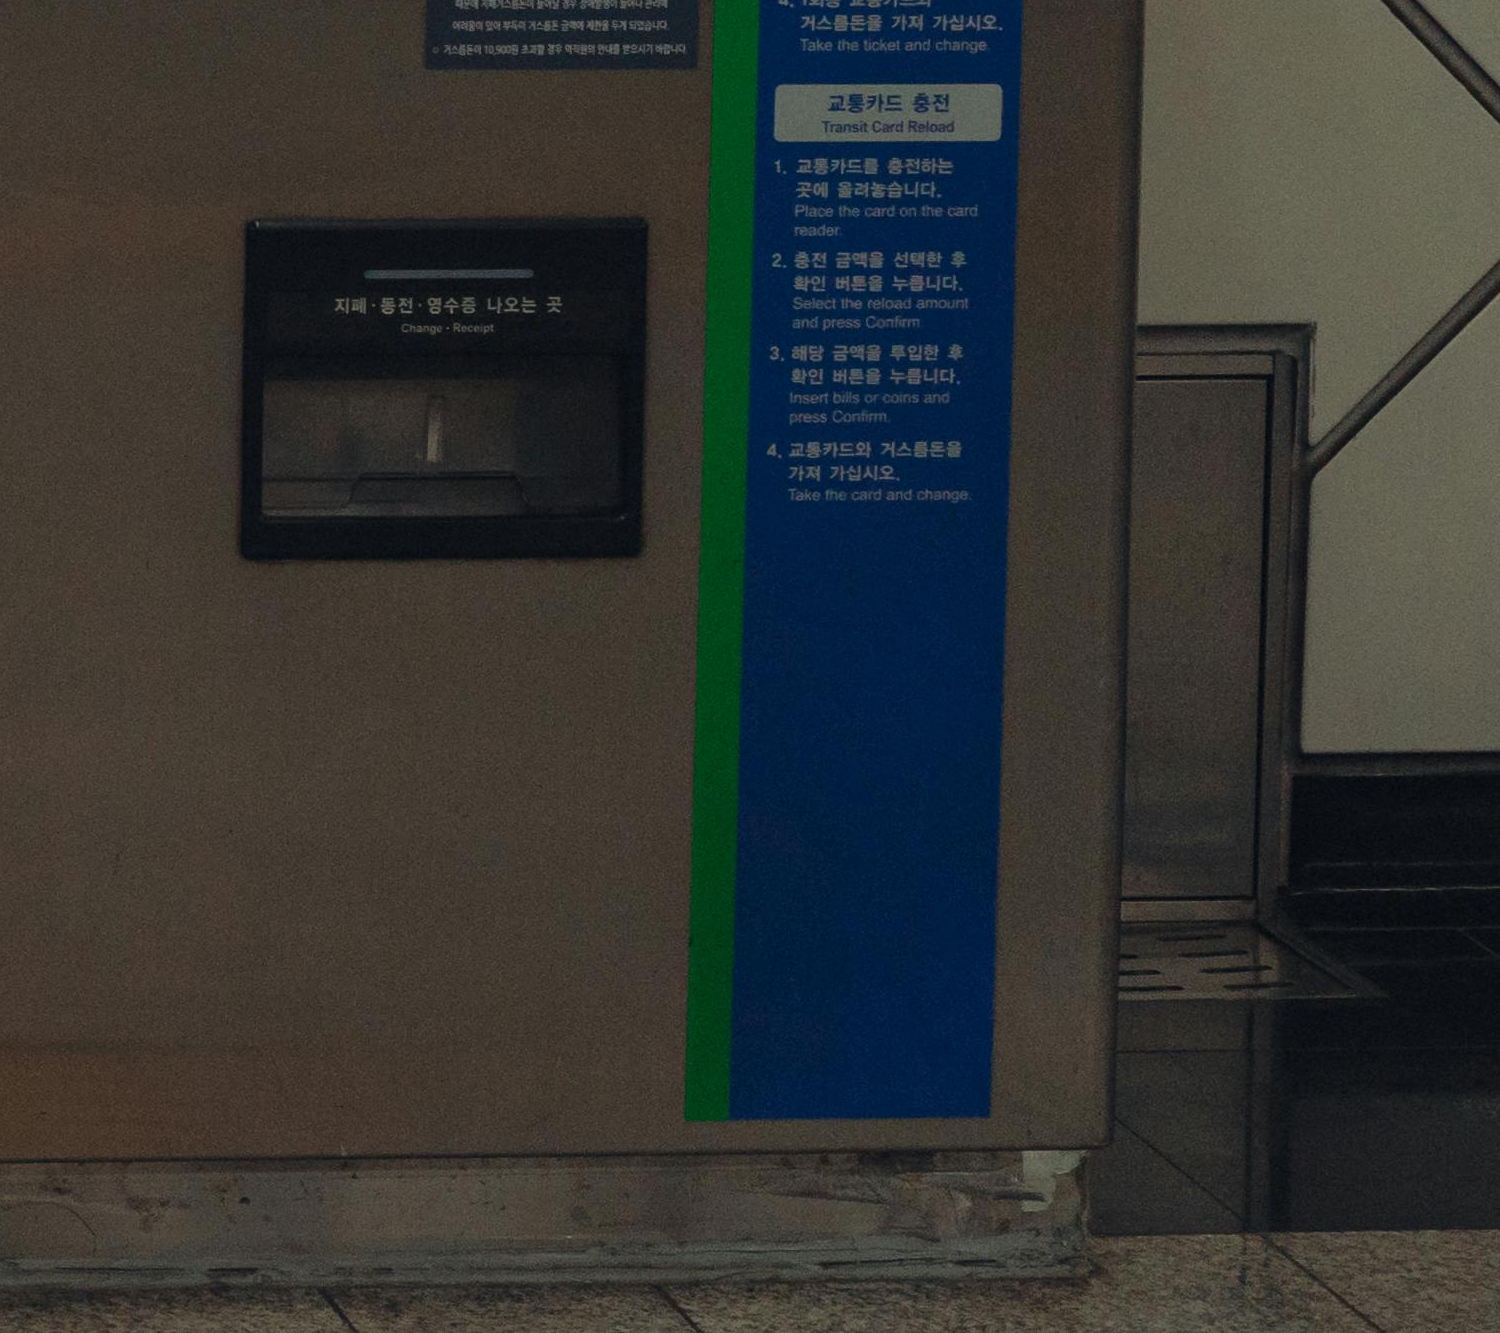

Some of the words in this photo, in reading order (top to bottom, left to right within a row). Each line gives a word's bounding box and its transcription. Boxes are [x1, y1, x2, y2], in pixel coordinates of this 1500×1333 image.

[821, 120, 869, 134] Transit
[871, 120, 904, 134] Card
[907, 120, 955, 134] Reload
[787, 487, 822, 502] Take
[824, 488, 848, 502] the
[850, 488, 883, 502] card
[885, 488, 913, 502] and
[916, 488, 972, 504] change.
